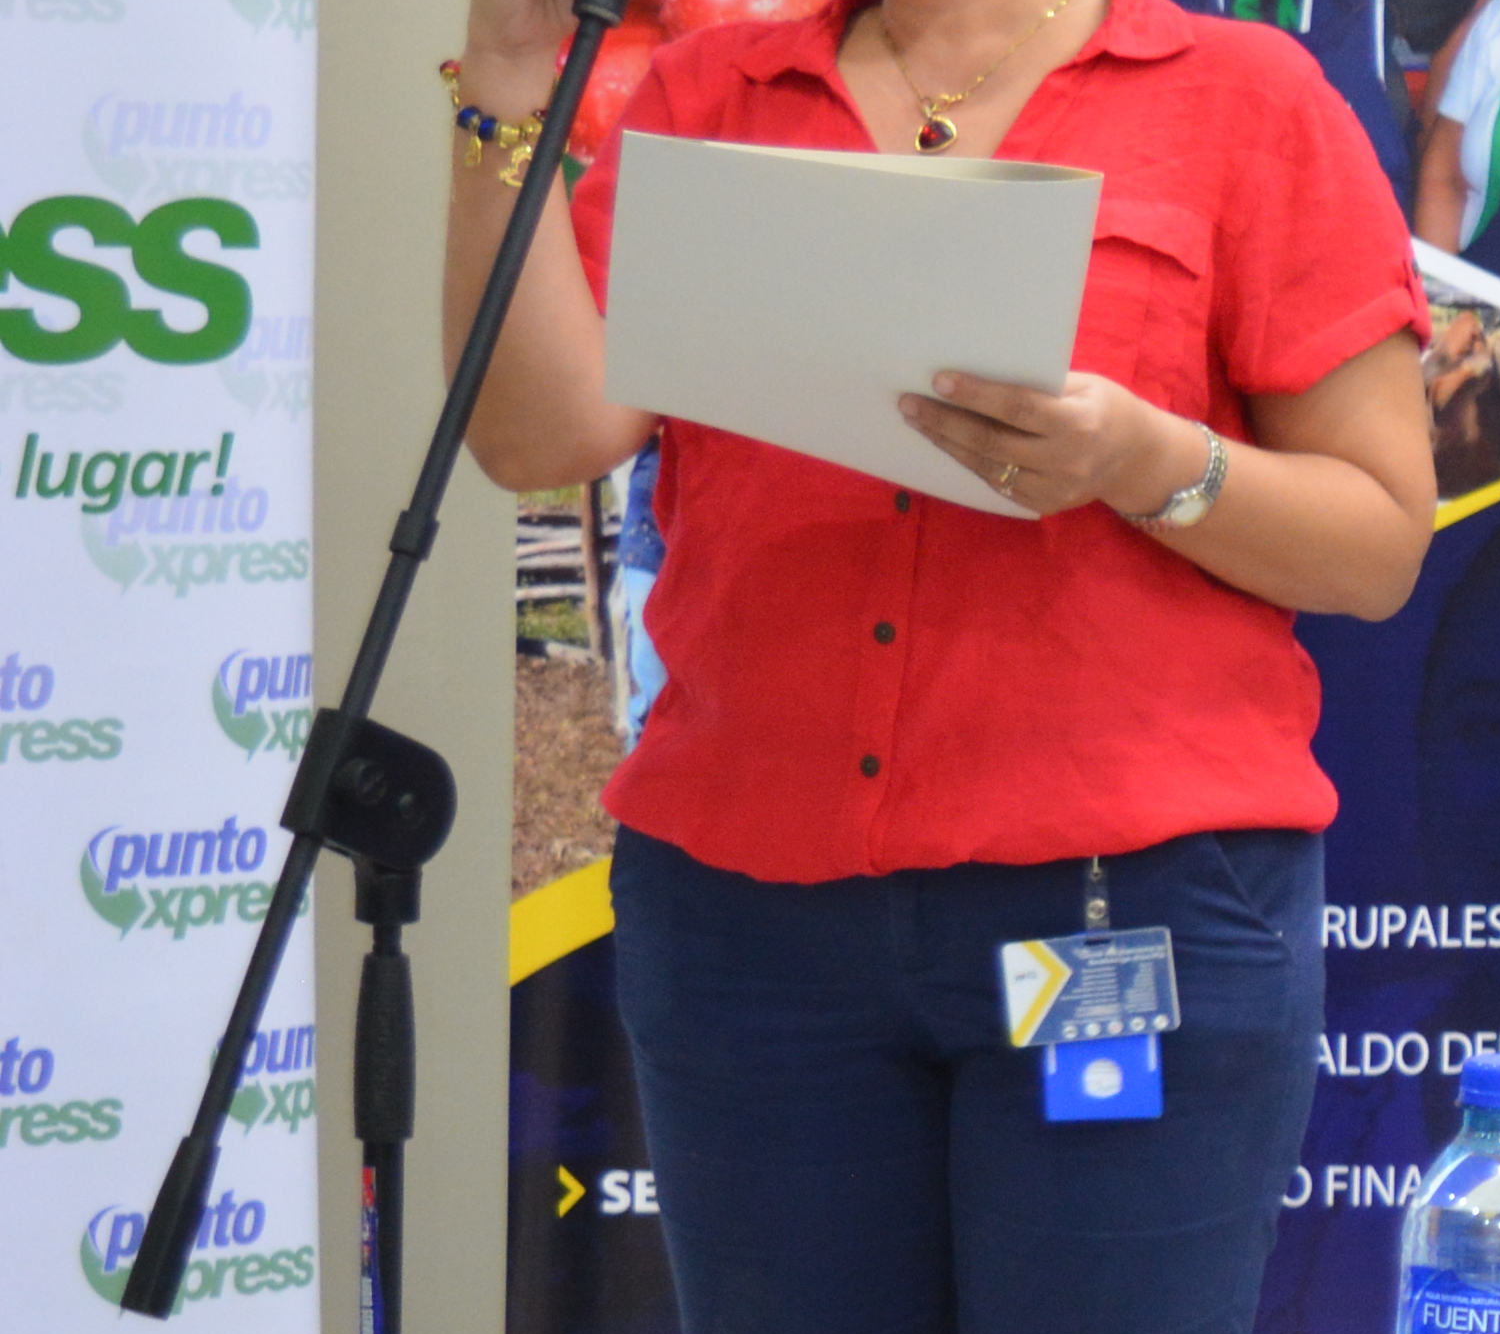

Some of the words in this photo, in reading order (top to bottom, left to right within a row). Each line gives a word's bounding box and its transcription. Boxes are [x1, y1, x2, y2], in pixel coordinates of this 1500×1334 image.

[107, 90, 272, 158] punto
[15, 431, 234, 515] lugar!
[104, 473, 268, 545] punto
[145, 535, 310, 599] xpress
[104, 815, 267, 892] punto
[104, 1188, 266, 1273] pto
